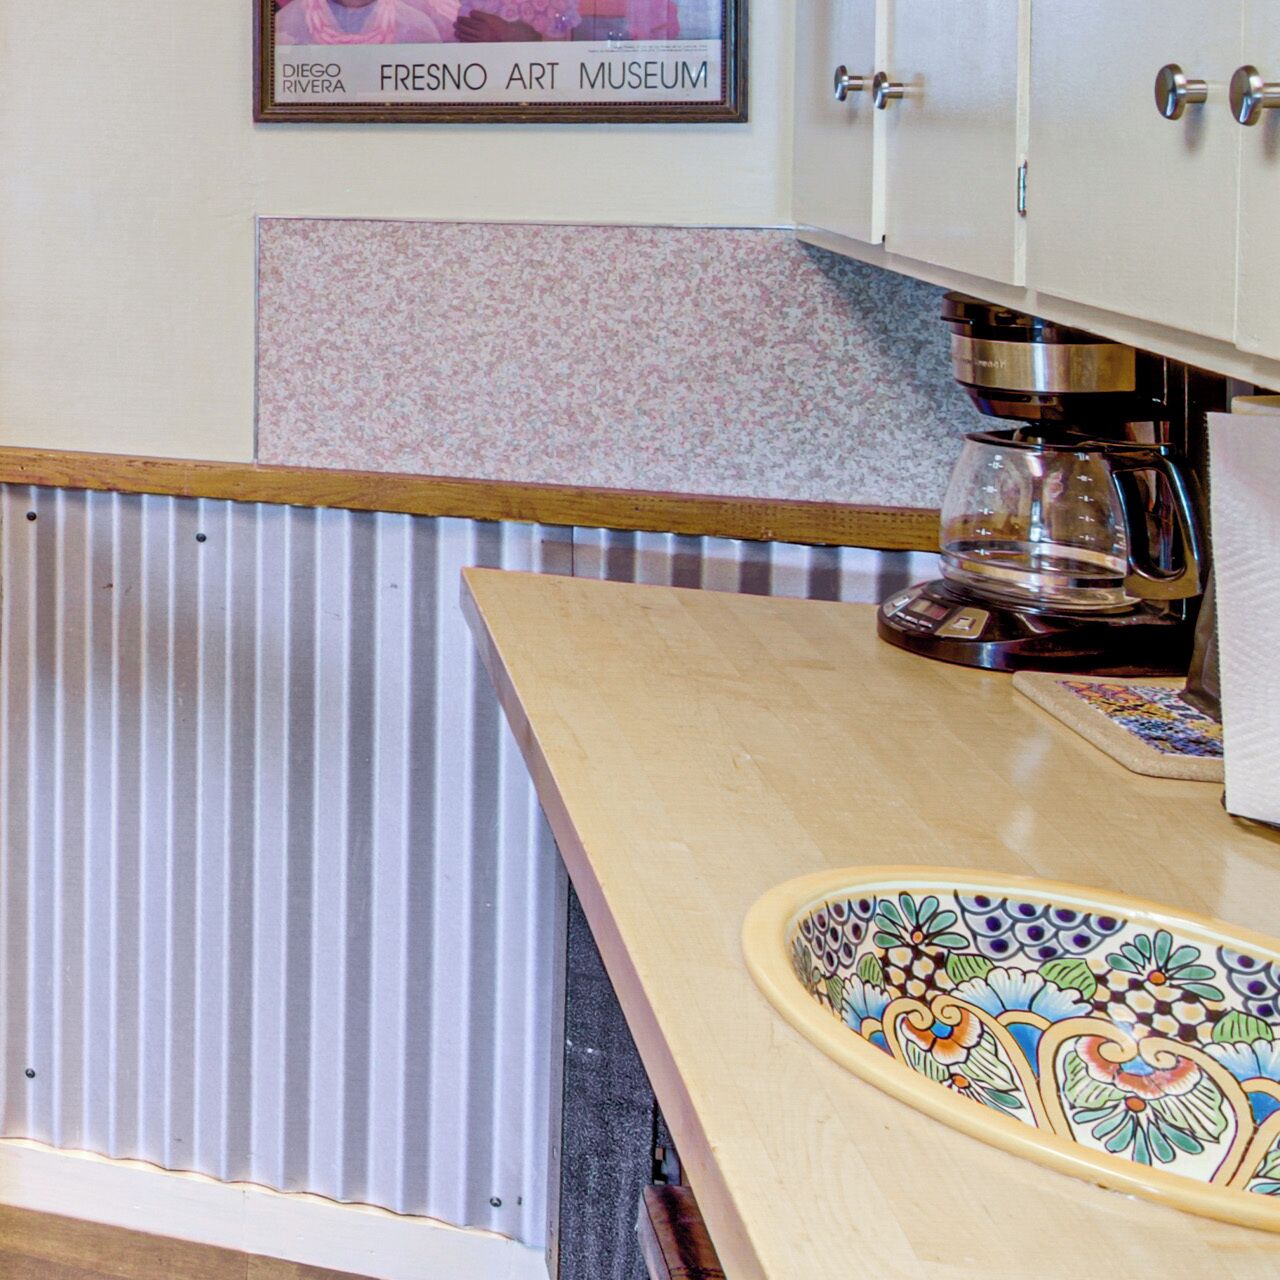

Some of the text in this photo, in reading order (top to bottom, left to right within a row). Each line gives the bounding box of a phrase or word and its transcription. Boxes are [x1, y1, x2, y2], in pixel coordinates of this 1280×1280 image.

[282, 63, 341, 78] DIEGO
[380, 60, 708, 91] FRESNO ART MUSEUM
[282, 79, 347, 94] RIVERA
